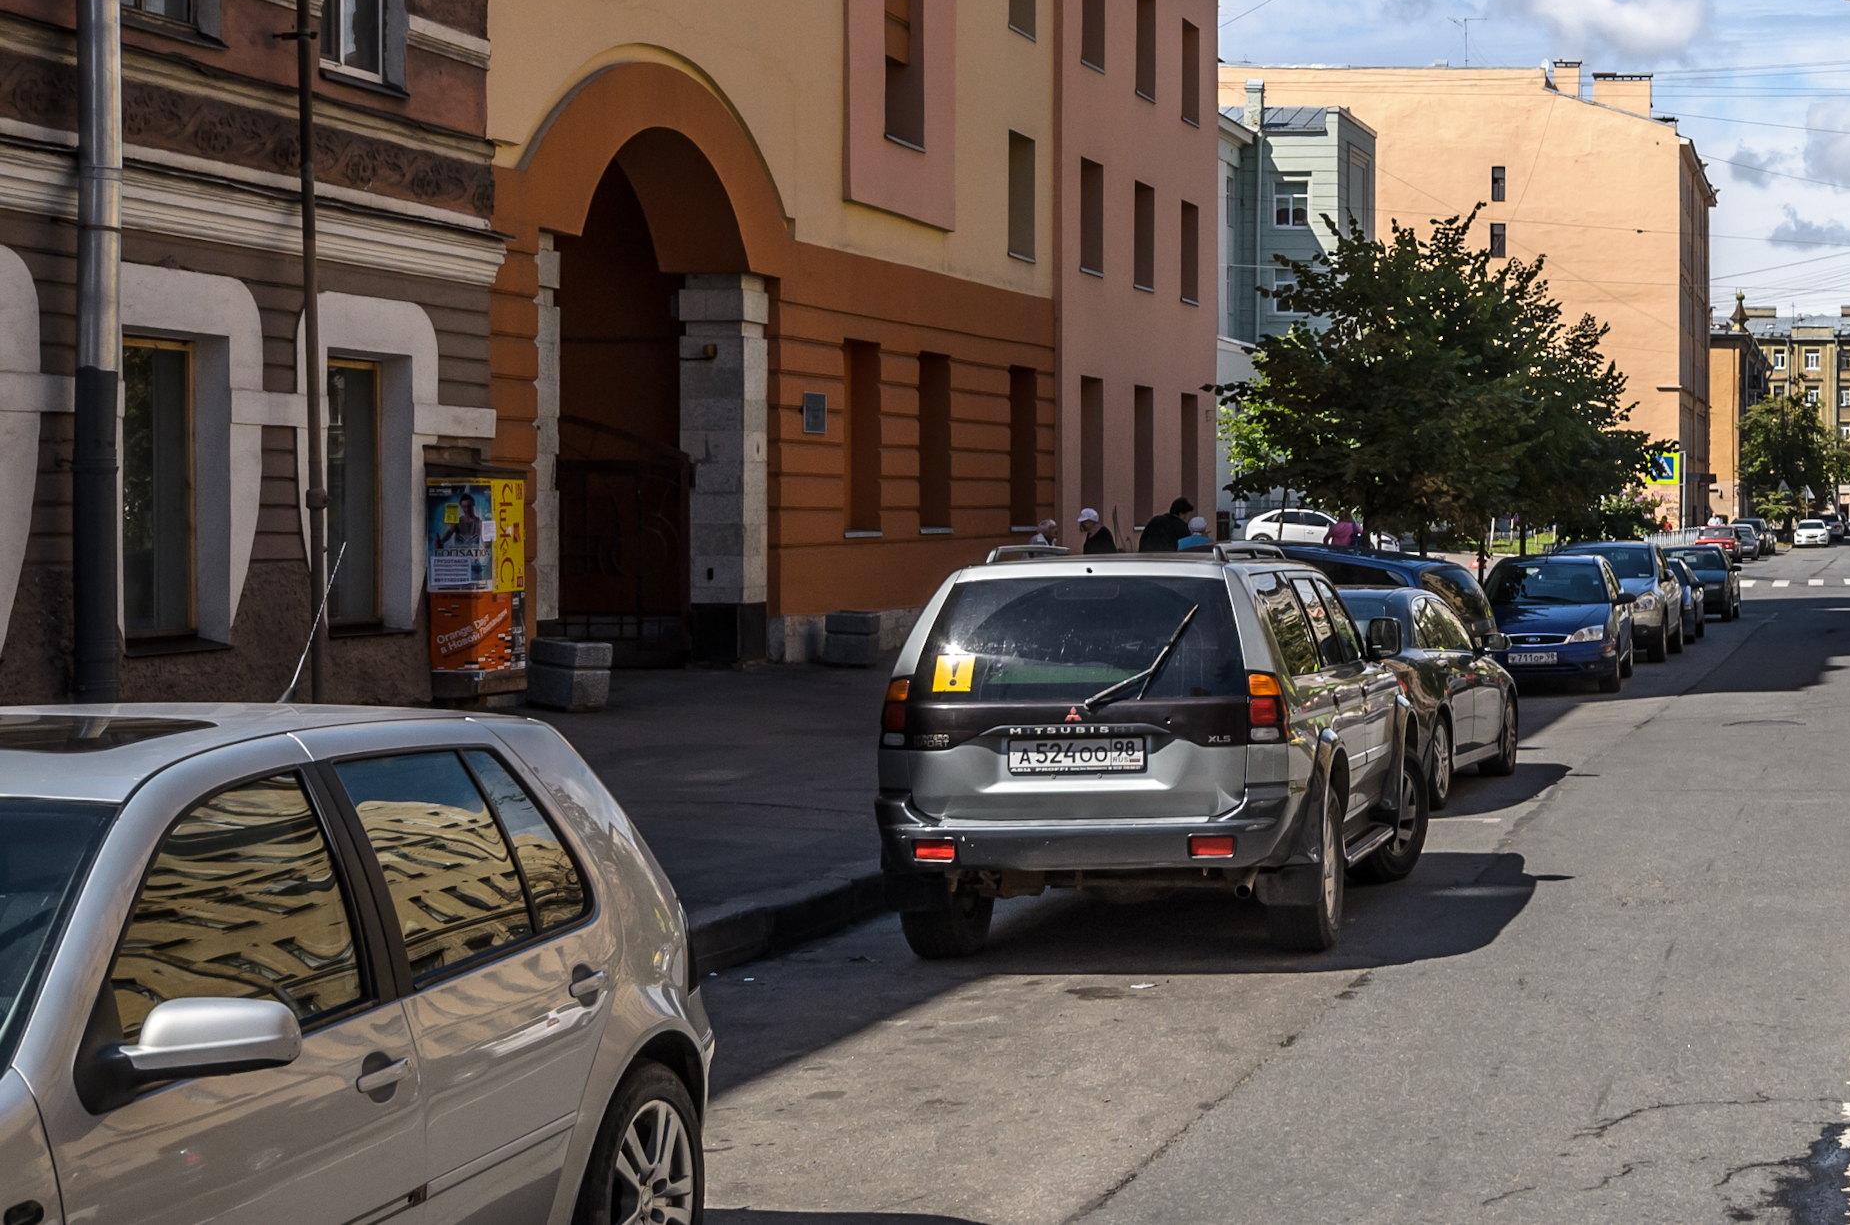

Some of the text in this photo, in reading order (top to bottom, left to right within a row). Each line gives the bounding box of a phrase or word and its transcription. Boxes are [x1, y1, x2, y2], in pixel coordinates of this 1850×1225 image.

[437, 625, 473, 644] Orange
[448, 631, 480, 650] Новой
[1208, 735, 1231, 743] XLS
[1018, 740, 1136, 765] А524ОО 98
